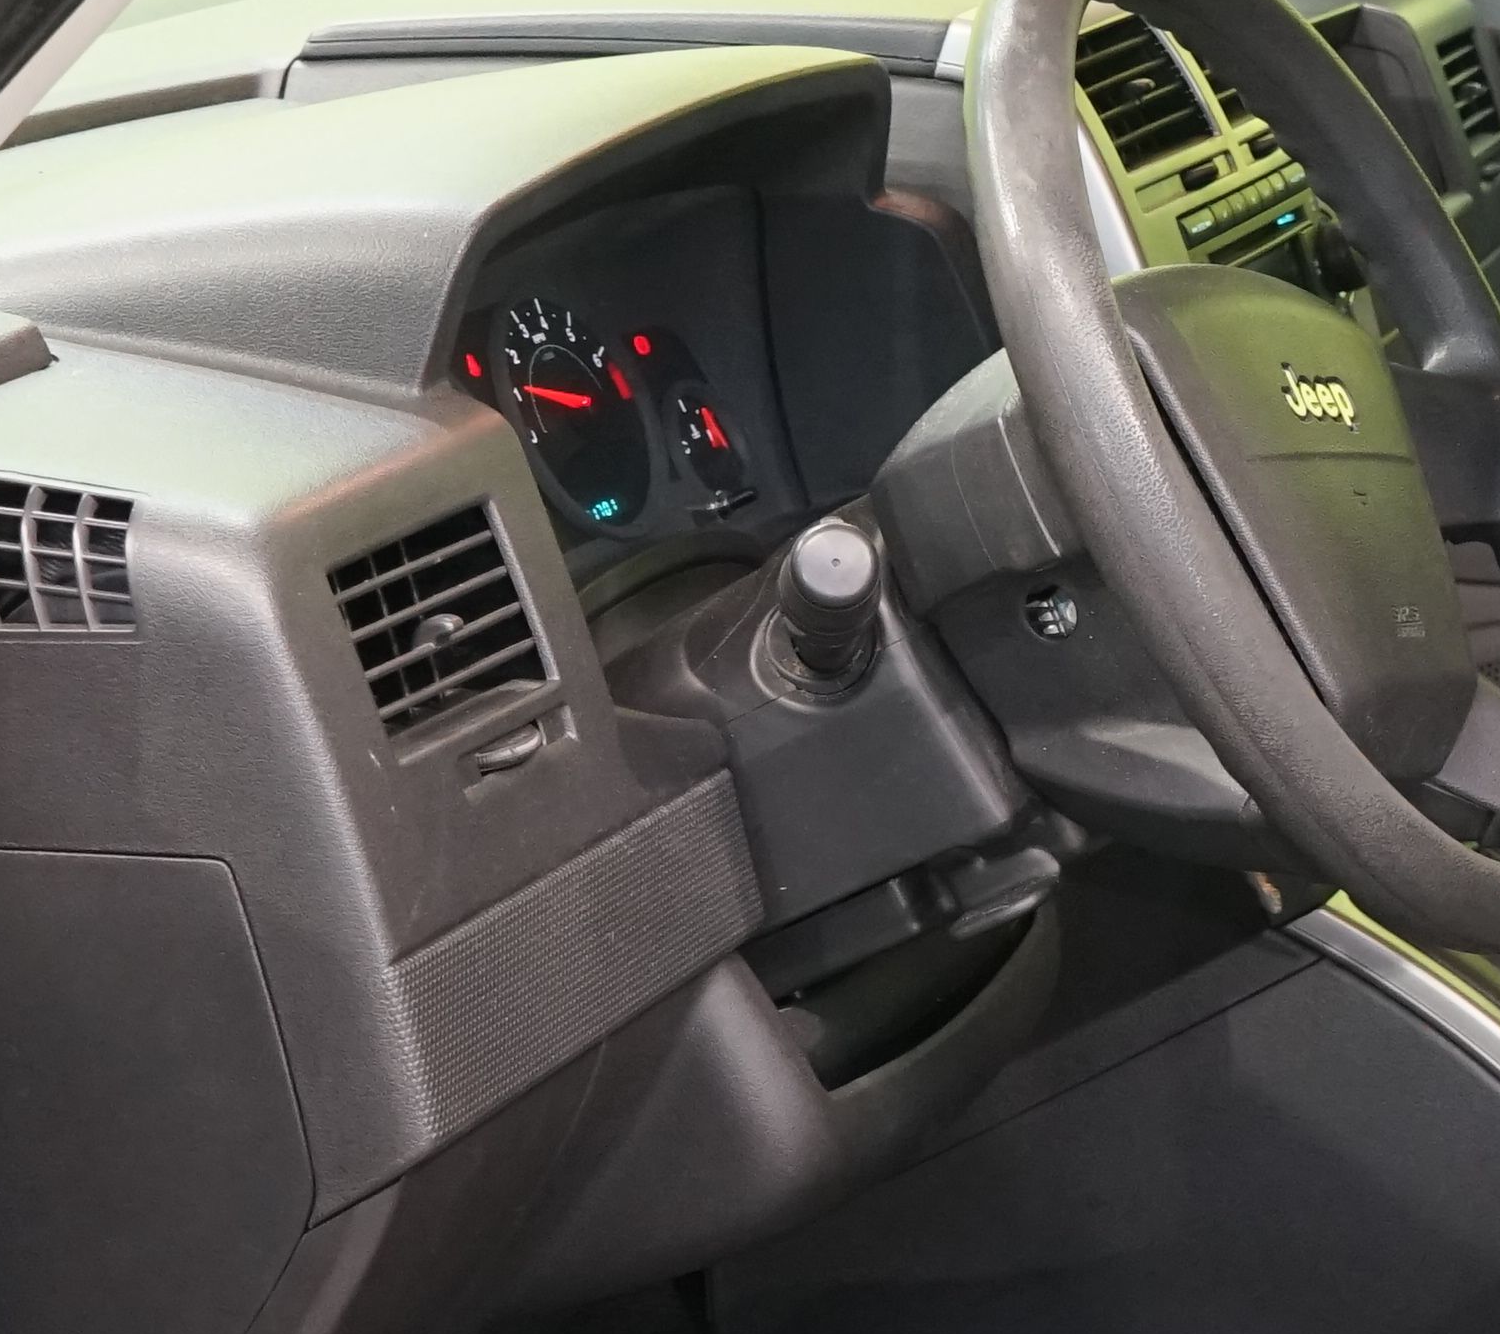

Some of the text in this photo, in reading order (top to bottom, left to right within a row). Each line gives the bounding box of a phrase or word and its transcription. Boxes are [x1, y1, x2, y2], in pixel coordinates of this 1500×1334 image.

[518, 323, 530, 338] 3
[565, 327, 576, 342] 5
[1281, 362, 1357, 432] Jeep
